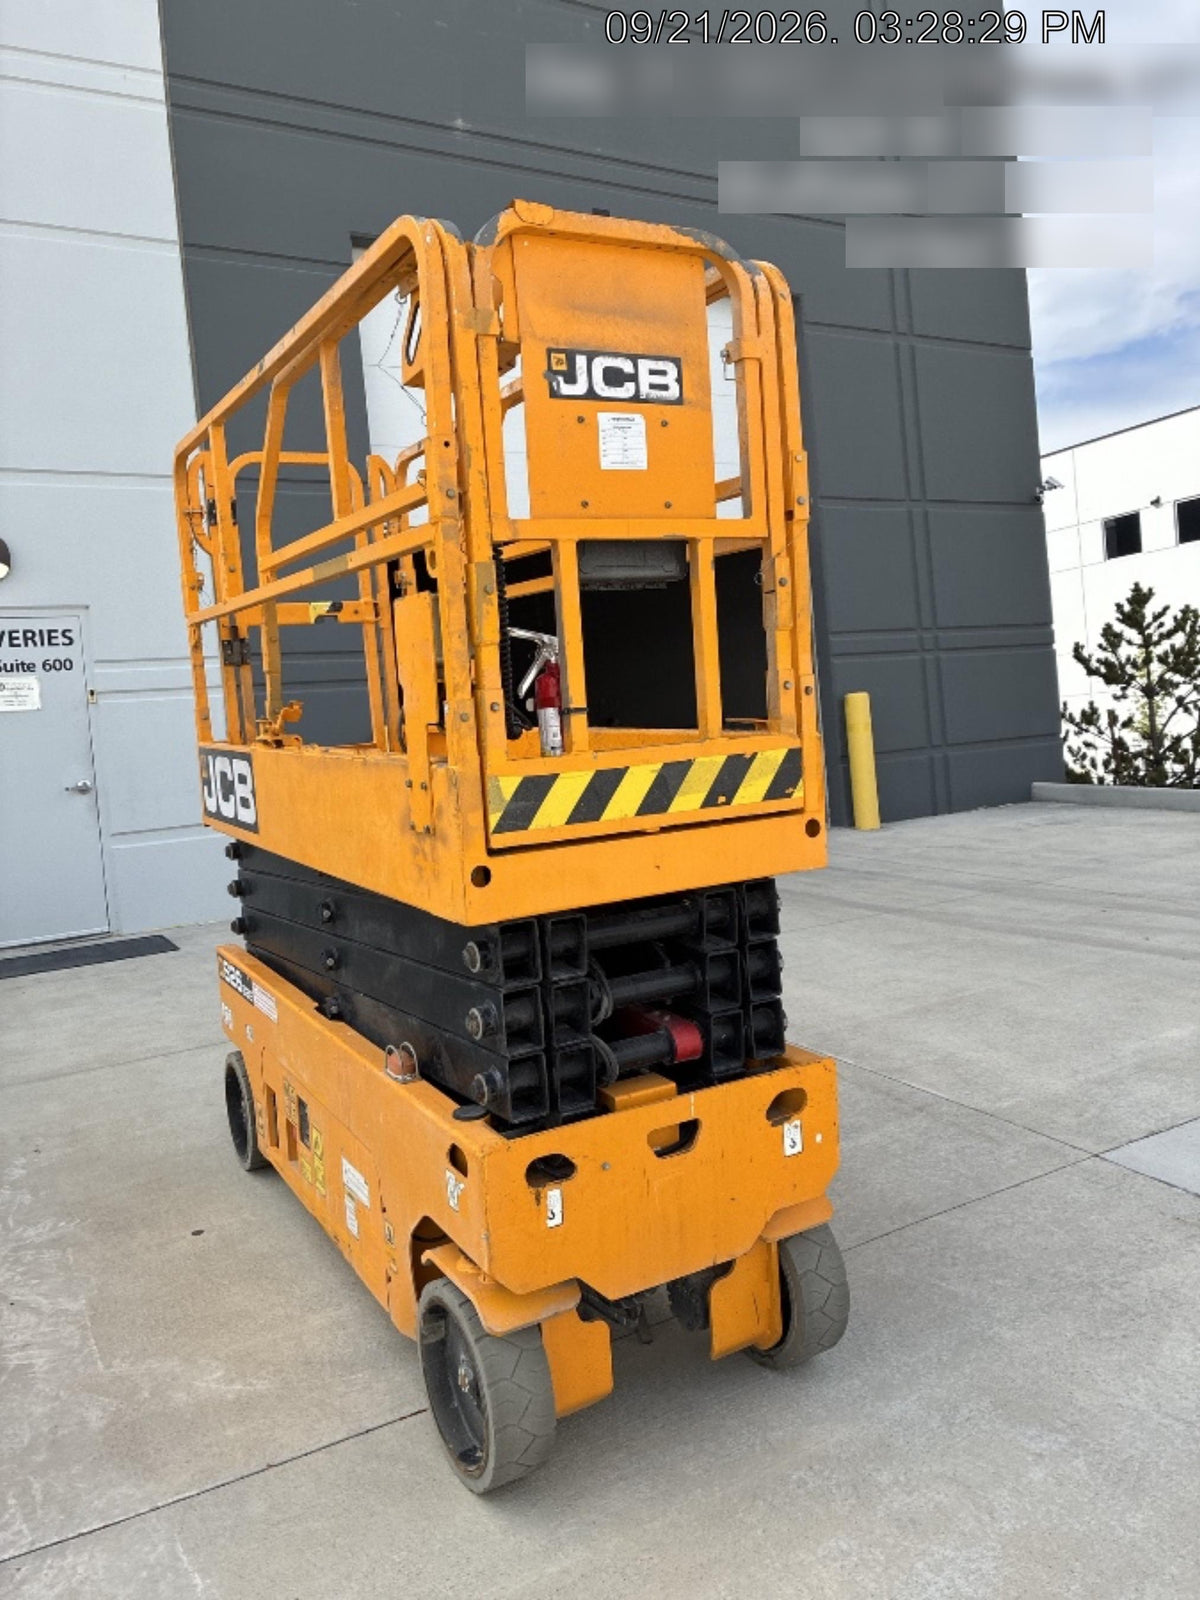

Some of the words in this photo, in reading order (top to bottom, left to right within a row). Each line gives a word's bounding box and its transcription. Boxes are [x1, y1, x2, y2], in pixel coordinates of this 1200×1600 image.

[552, 353, 680, 401] JCB
[0, 658, 36, 673] uite
[42, 658, 73, 672] 600
[204, 755, 256, 825] JCB
